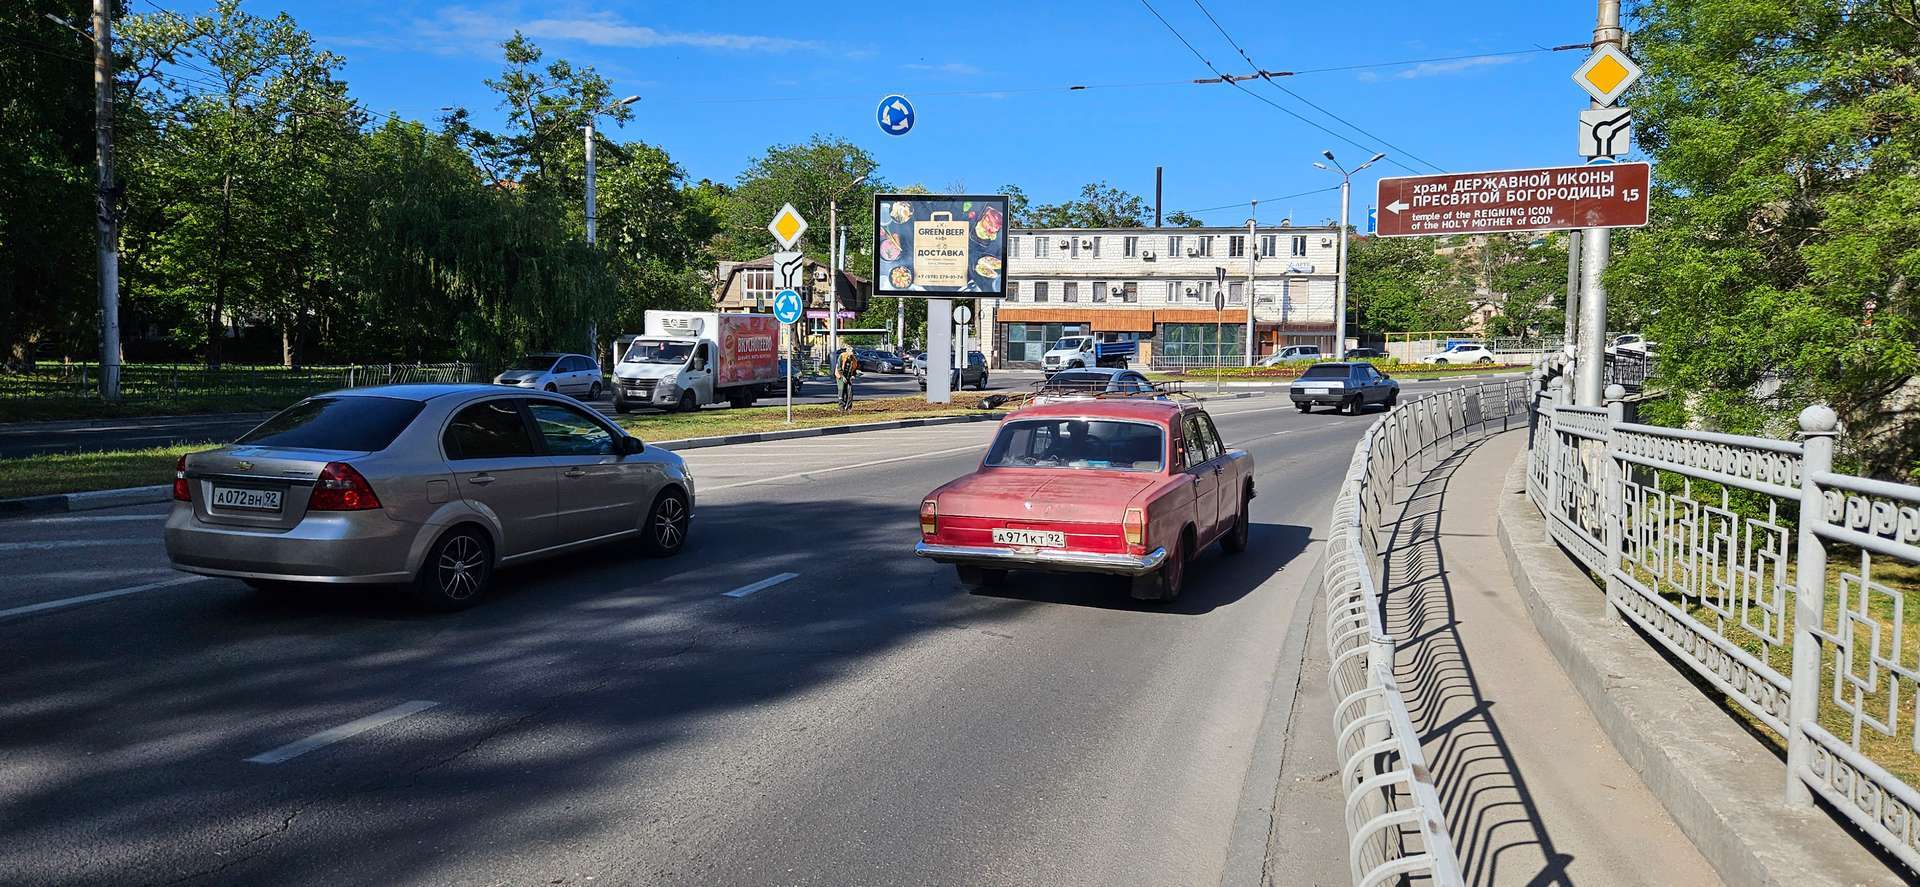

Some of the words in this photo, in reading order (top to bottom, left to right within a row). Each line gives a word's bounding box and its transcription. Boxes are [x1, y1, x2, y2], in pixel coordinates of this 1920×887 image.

[1413, 183, 1447, 195] храм
[1453, 172, 1550, 193] ДЕРЖАВНОЙ
[1557, 171, 1614, 185] ИКОНЫ
[1413, 188, 1500, 207] ПРЕСВЯТОЙ
[1507, 185, 1615, 202] БОГОРОДИЦЫ
[1622, 188, 1640, 202] 1,5
[1412, 212, 1440, 222] temple
[1443, 211, 1452, 220] of
[1455, 211, 1471, 219] the
[1474, 207, 1524, 218] REIGNING
[1528, 206, 1553, 216] ICON
[1411, 221, 1420, 230] of
[1424, 221, 1439, 229] the
[1442, 219, 1470, 229] HOLY
[1472, 217, 1513, 228] MOTHER
[1517, 216, 1527, 225] of
[1530, 216, 1551, 225] GOD
[918, 228, 944, 236] GREEN
[945, 228, 964, 236] BEER
[918, 249, 964, 257] ДОСТАВКА
[217, 491, 263, 505] А072ВН
[265, 492, 277, 503] 92
[998, 531, 1044, 544] А971КТ
[1047, 533, 1060, 543] 92
